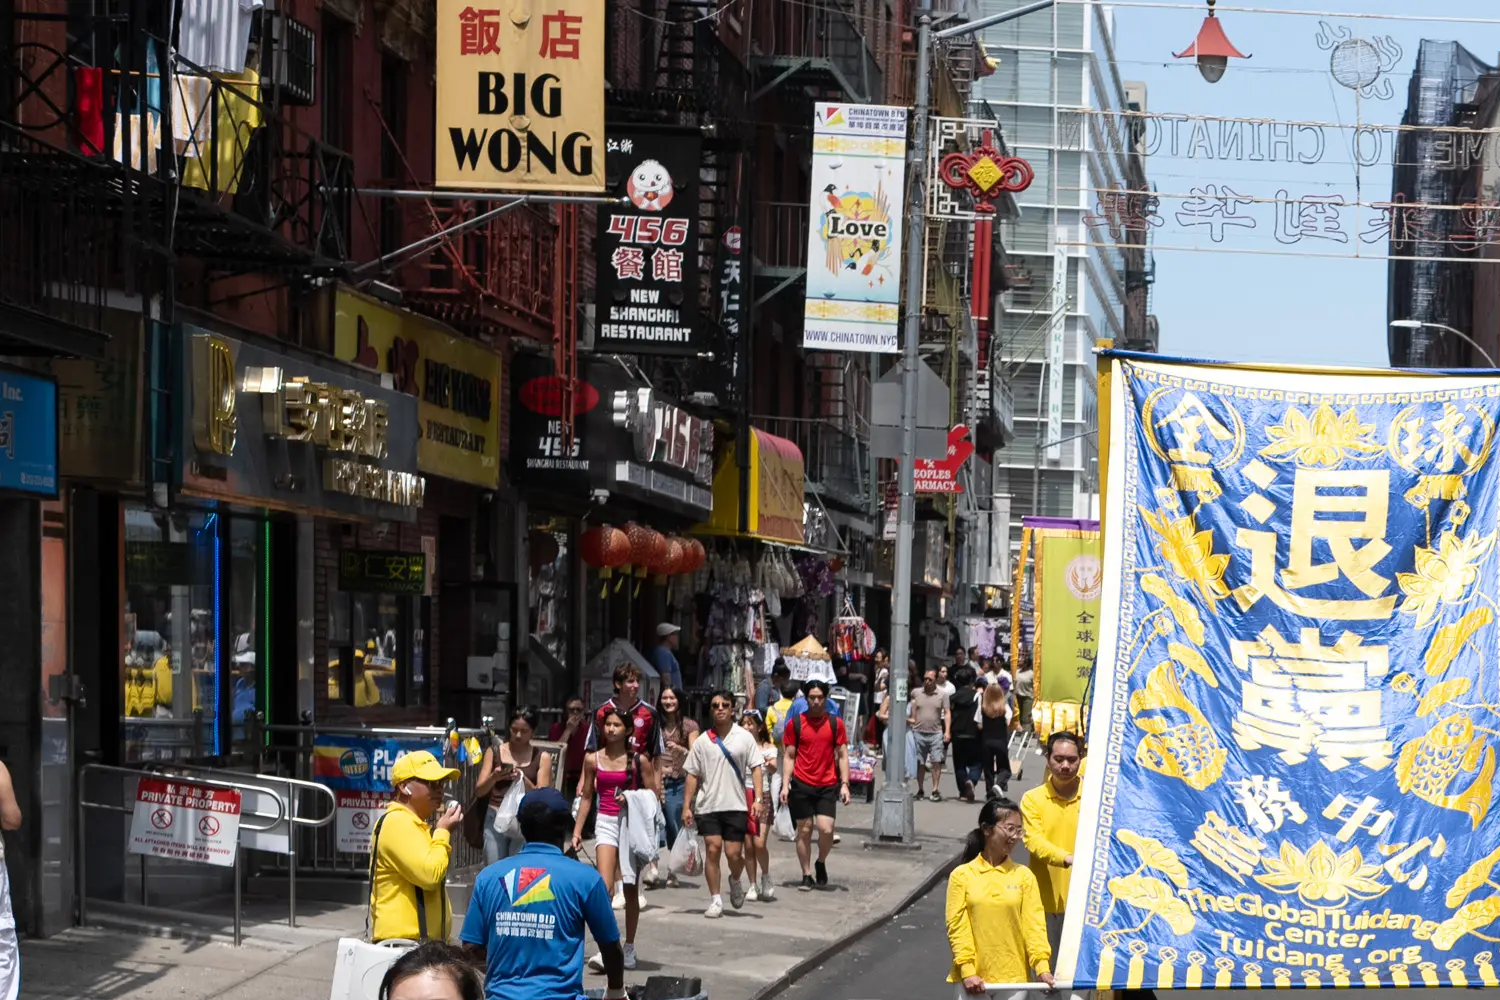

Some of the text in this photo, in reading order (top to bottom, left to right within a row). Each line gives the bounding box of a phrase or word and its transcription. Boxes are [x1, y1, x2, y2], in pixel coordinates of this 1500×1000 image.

[459, 6, 583, 60] 飯店
[478, 71, 562, 118] BIG
[848, 108, 890, 118] CHINATOWN
[448, 127, 593, 177] WONG
[606, 214, 690, 246] 456
[831, 216, 888, 238] Love
[613, 246, 685, 283] 餐館
[630, 289, 660, 304] NEW
[609, 306, 680, 325] SHANGHAI
[601, 323, 692, 343] RESTAURANT
[805, 329, 897, 347] WWW.CHINATOWN.NYC
[424, 358, 450, 409] BIG
[1155, 391, 1482, 473] 全 球
[914, 469, 951, 480] EOPLES
[914, 480, 957, 491] ARMACY
[1231, 467, 1402, 771] 退黨
[373, 748, 411, 765] PLA
[141, 790, 237, 814] PRIVATE PROPERTY
[340, 798, 376, 808] PRIVATE
[495, 912, 556, 925] CHINATOWN BID
[1264, 921, 1376, 949] Center
